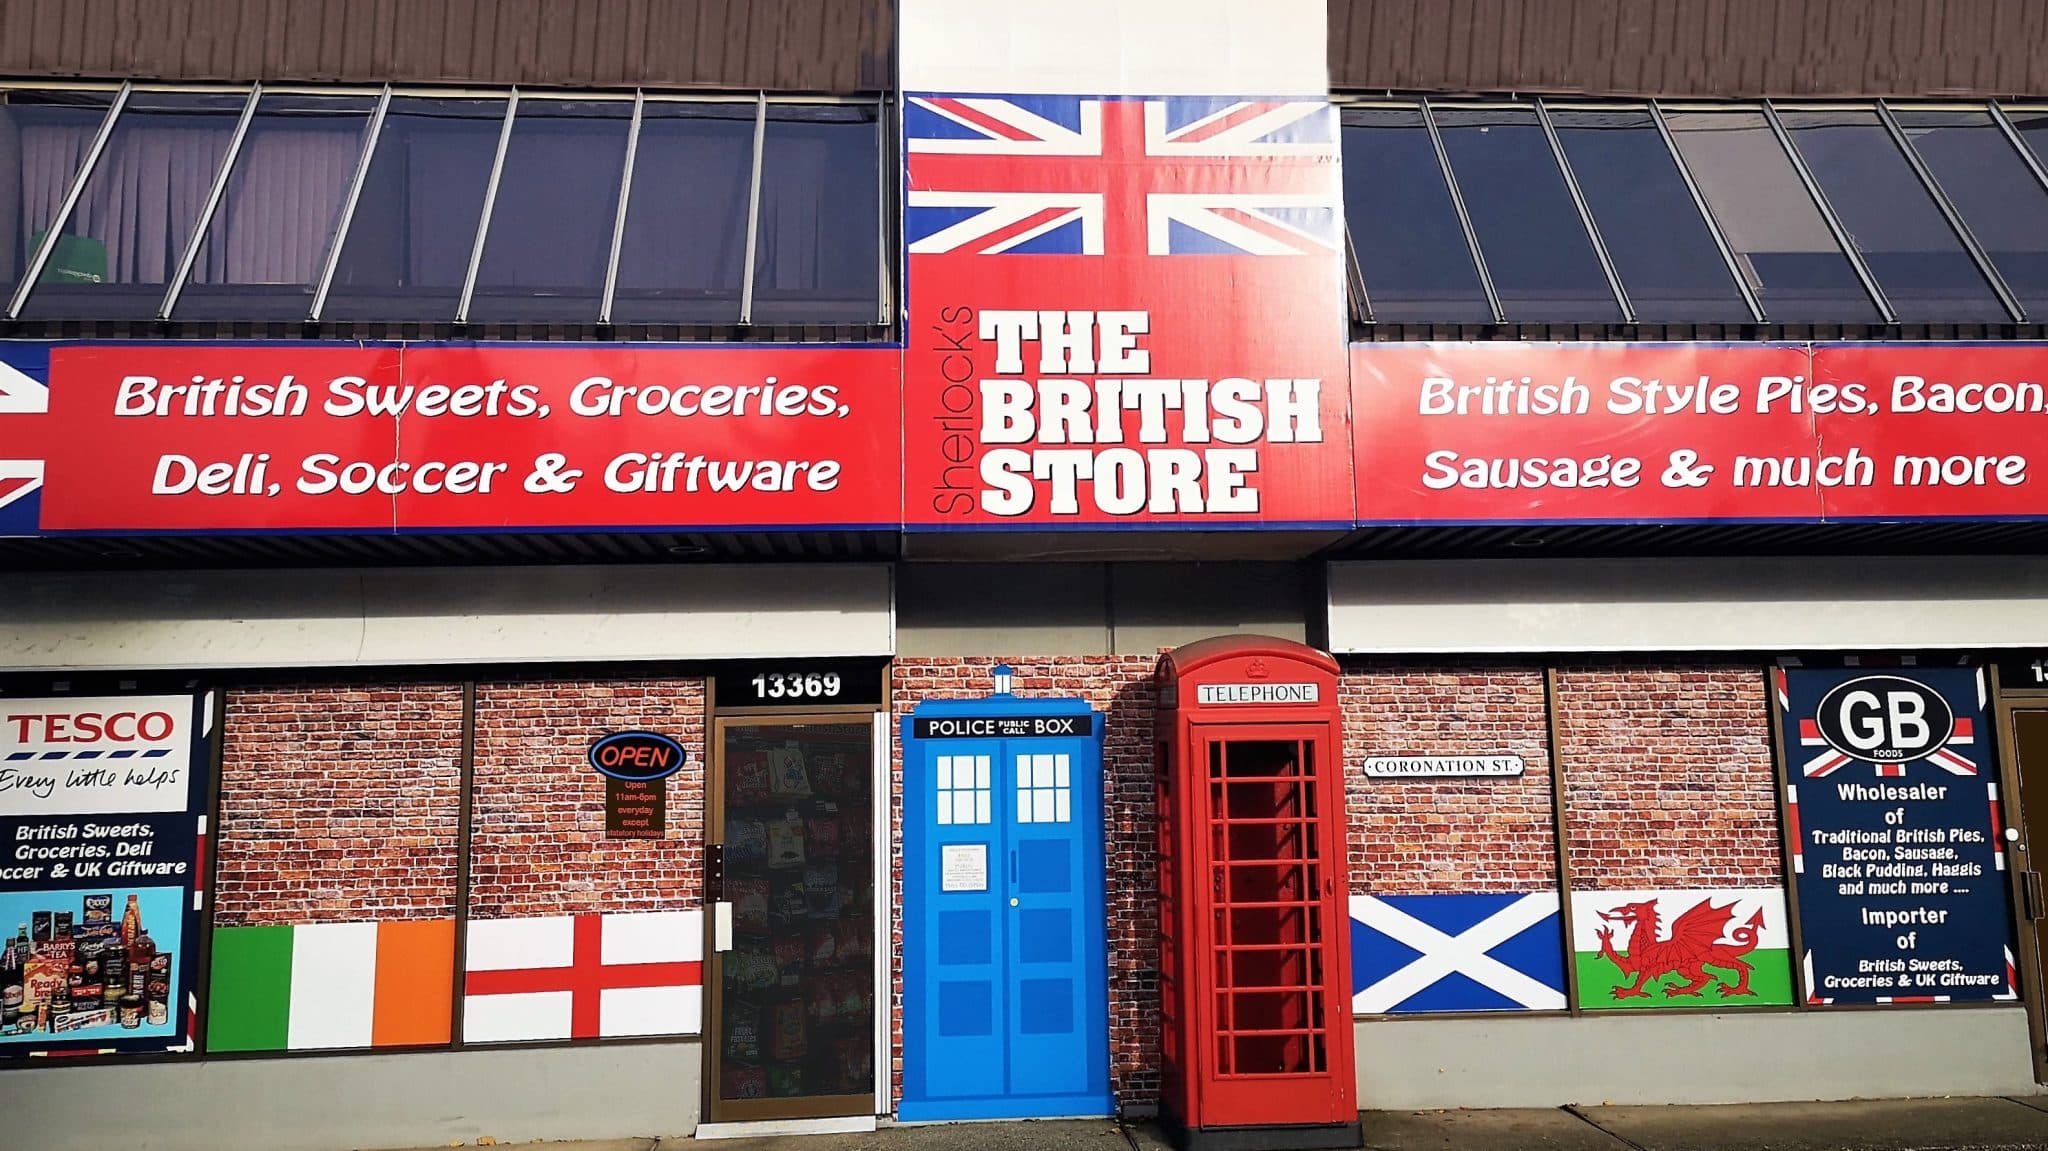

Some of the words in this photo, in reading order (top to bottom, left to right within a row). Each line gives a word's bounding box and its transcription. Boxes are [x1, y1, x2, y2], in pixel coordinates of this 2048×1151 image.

[978, 310, 1150, 374] THE
[114, 375, 309, 417] British
[323, 375, 551, 419] Sweets,
[569, 376, 850, 419] Groceries,
[1419, 376, 1591, 416] British
[1606, 375, 1741, 415] Style
[1756, 375, 1879, 416] Pies,
[933, 306, 973, 515] Sherlock's
[979, 378, 1323, 445] BRITISH
[152, 453, 281, 497] Deli,
[296, 453, 508, 495] Soccer
[523, 453, 584, 493] &
[603, 451, 842, 492] Giftware
[1422, 449, 1642, 490] Sausage
[1660, 449, 1715, 488] &
[1733, 448, 1875, 487] much
[1893, 455, 2027, 486] more
[979, 447, 1260, 516] STORE
[2031, 660, 2048, 682] 1
[752, 672, 841, 698] 13369
[1202, 685, 1313, 702] TELEPHONE
[7, 712, 174, 743] TESCO
[929, 720, 996, 736] POLICE
[998, 720, 1030, 728] PUBLIC
[1034, 719, 1074, 734] BOX
[1839, 690, 1930, 750] GB
[1003, 727, 1026, 735] CALL
[601, 745, 671, 768] OPEN
[1873, 749, 1903, 758] FOODS
[1374, 759, 1486, 773] CORONATION
[1492, 759, 1513, 772] ST.
[0, 768, 56, 799] Every
[65, 768, 117, 788] little
[123, 767, 181, 790] helps
[624, 781, 647, 790] Open
[1837, 783, 1948, 801] Wholesaler
[617, 806, 654, 816] everyday
[1885, 808, 1905, 825] of
[15, 823, 78, 841] British
[82, 824, 155, 839] Sweets,
[1812, 829, 1891, 844] Traditional
[1896, 829, 1946, 843] British
[1949, 829, 1985, 842] Pies,
[15, 843, 111, 860] Groceries,
[115, 841, 153, 857] Deli
[1842, 847, 1890, 861] Bacon,
[1894, 847, 1959, 861] Sausage,
[50, 862, 70, 879] &
[74, 862, 102, 877] UK
[107, 860, 187, 878] Giftware
[1822, 863, 1862, 879] Black
[1866, 863, 1928, 879] Pudding,
[1932, 862, 1982, 877] Haggis
[1838, 880, 1864, 895] and
[1869, 880, 1906, 894] much
[1911, 882, 1948, 894] more
[1862, 907, 1948, 928] Importer
[1896, 932, 1917, 949] of
[1858, 959, 1905, 973] British
[1908, 959, 1963, 972] Sweets,
[30, 979, 62, 989] Ready
[1824, 975, 1893, 989] Groceries
[1897, 975, 1912, 988] &
[1915, 975, 1936, 987] UK
[1940, 974, 2000, 987] Giftware
